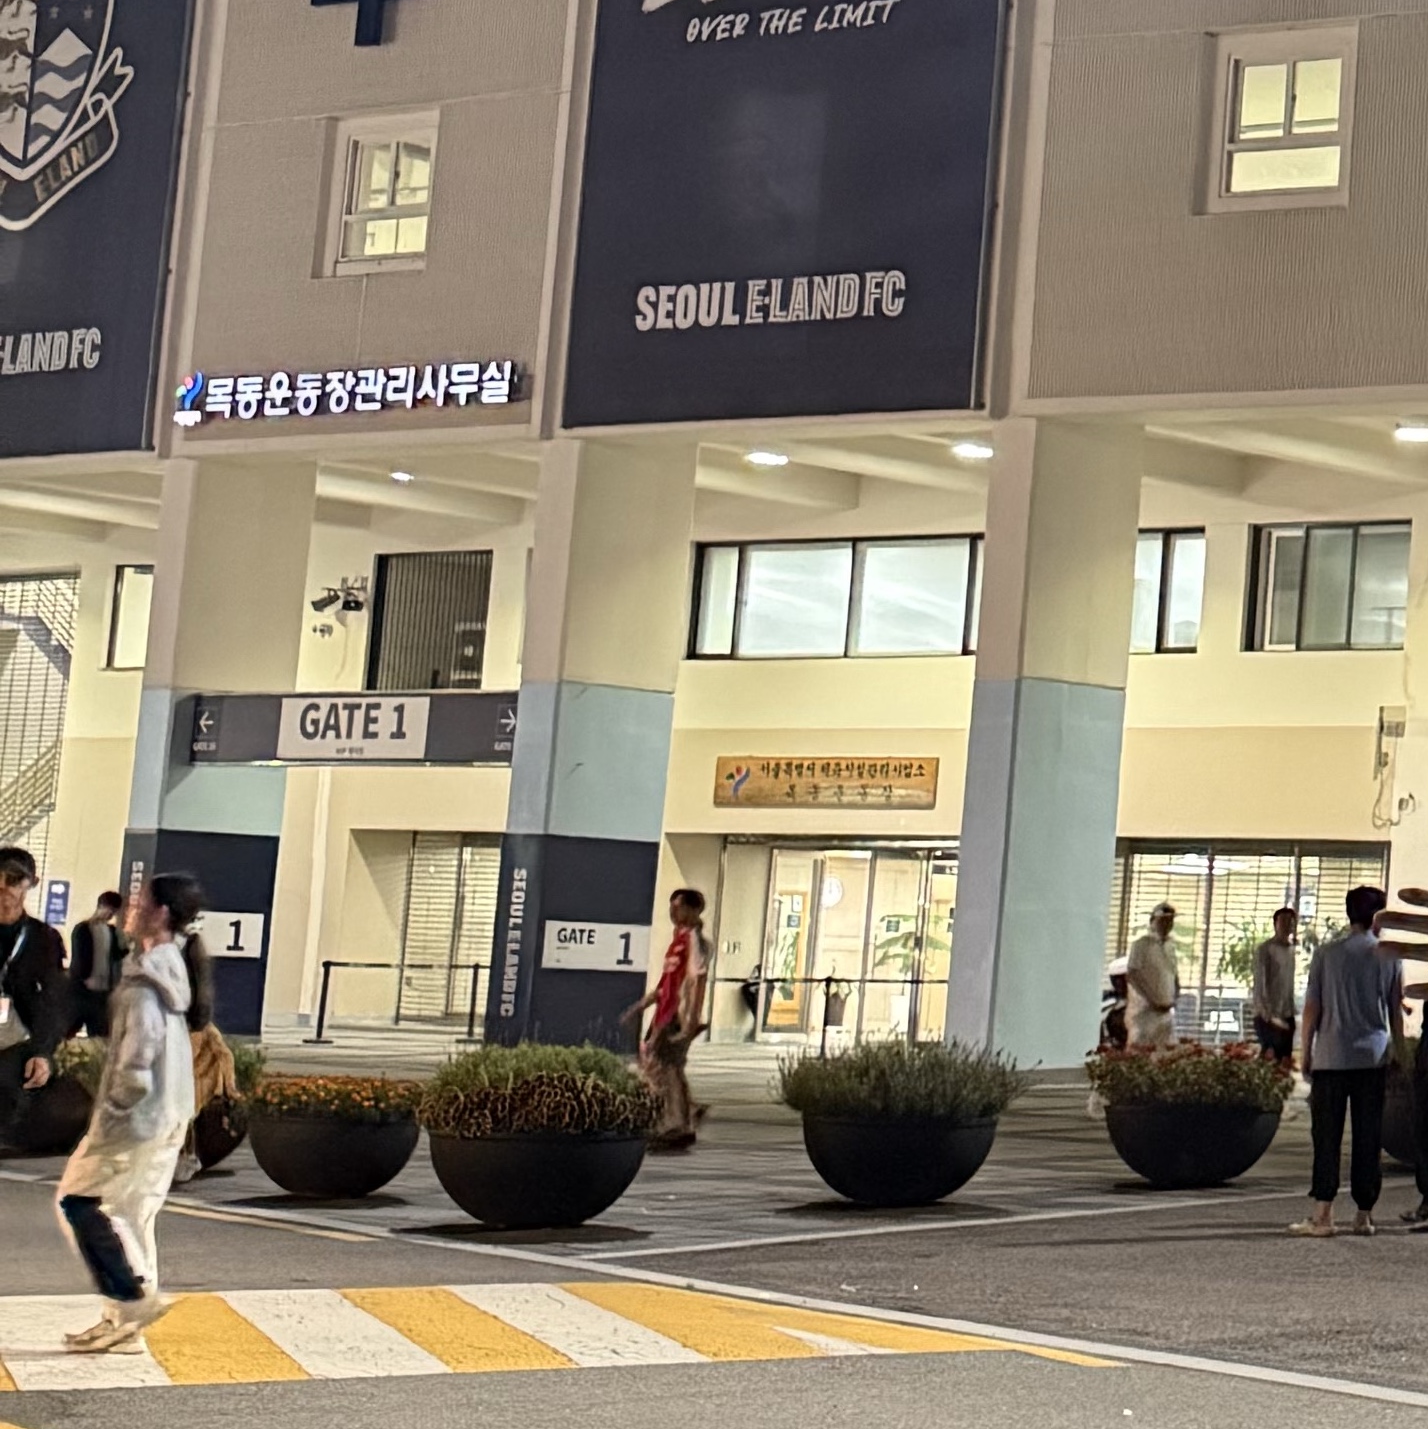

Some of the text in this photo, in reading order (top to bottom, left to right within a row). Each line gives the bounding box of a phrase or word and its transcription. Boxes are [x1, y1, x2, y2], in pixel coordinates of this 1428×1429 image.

[686, 12, 746, 42] OVER
[759, 7, 804, 35] THE
[635, 281, 740, 331] SEOUL
[862, 270, 907, 318] FC
[69, 327, 101, 369] FC
[205, 360, 512, 420] 목동운동장관리사무실
[300, 702, 406, 740] GATE 1
[508, 868, 527, 927] SEOUL
[226, 919, 244, 951] 1
[557, 927, 633, 965] GATE 1
